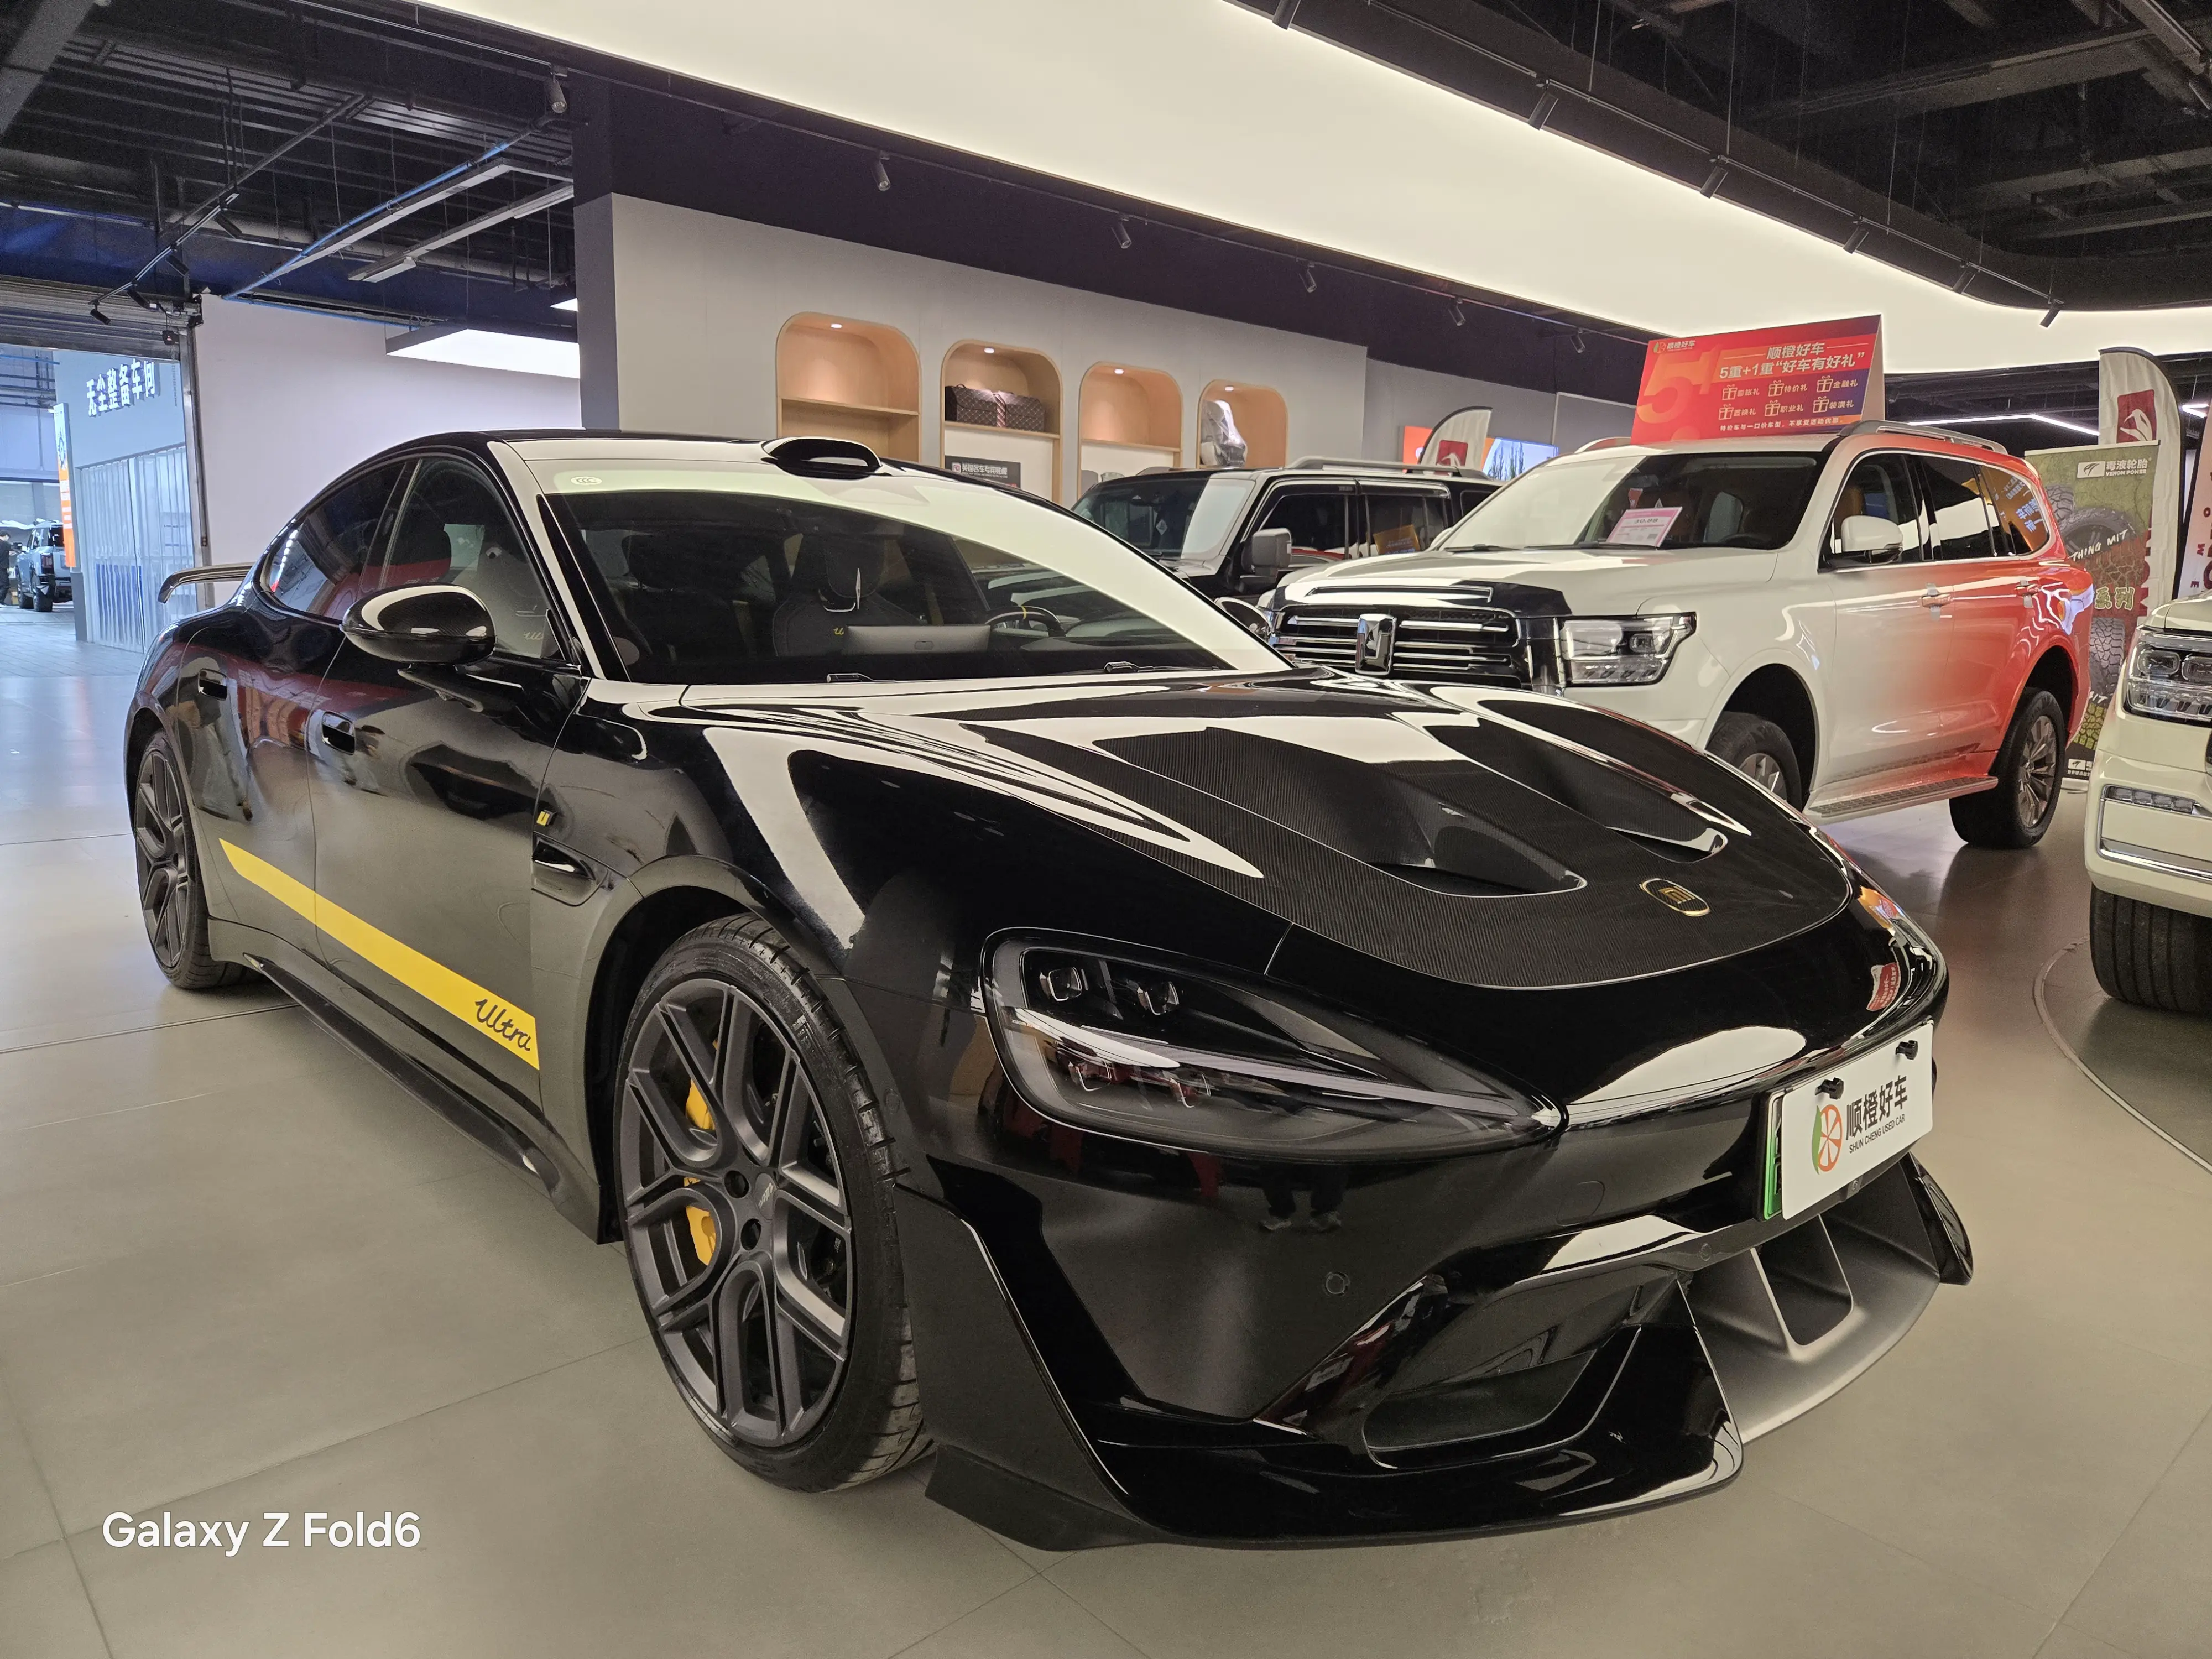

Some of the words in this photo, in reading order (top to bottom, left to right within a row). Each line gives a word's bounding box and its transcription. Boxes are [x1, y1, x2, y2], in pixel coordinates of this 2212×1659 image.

[1766, 342, 1825, 359] 顺橙好车
[86, 358, 155, 416] 无尘整备车间
[1784, 384, 1808, 393] 特价礼
[1833, 379, 1858, 389] 金融礼
[1780, 404, 1804, 413] 职业礼
[2094, 586, 2135, 611] 系列
[475, 999, 531, 1051] Ultra
[1846, 1075, 1908, 1141] 顺橙好车
[1849, 1138, 1864, 1154] SHUN
[1864, 1128, 1882, 1145] CHENG
[1882, 1120, 1895, 1134] USED
[1896, 1114, 1905, 1126] CAR
